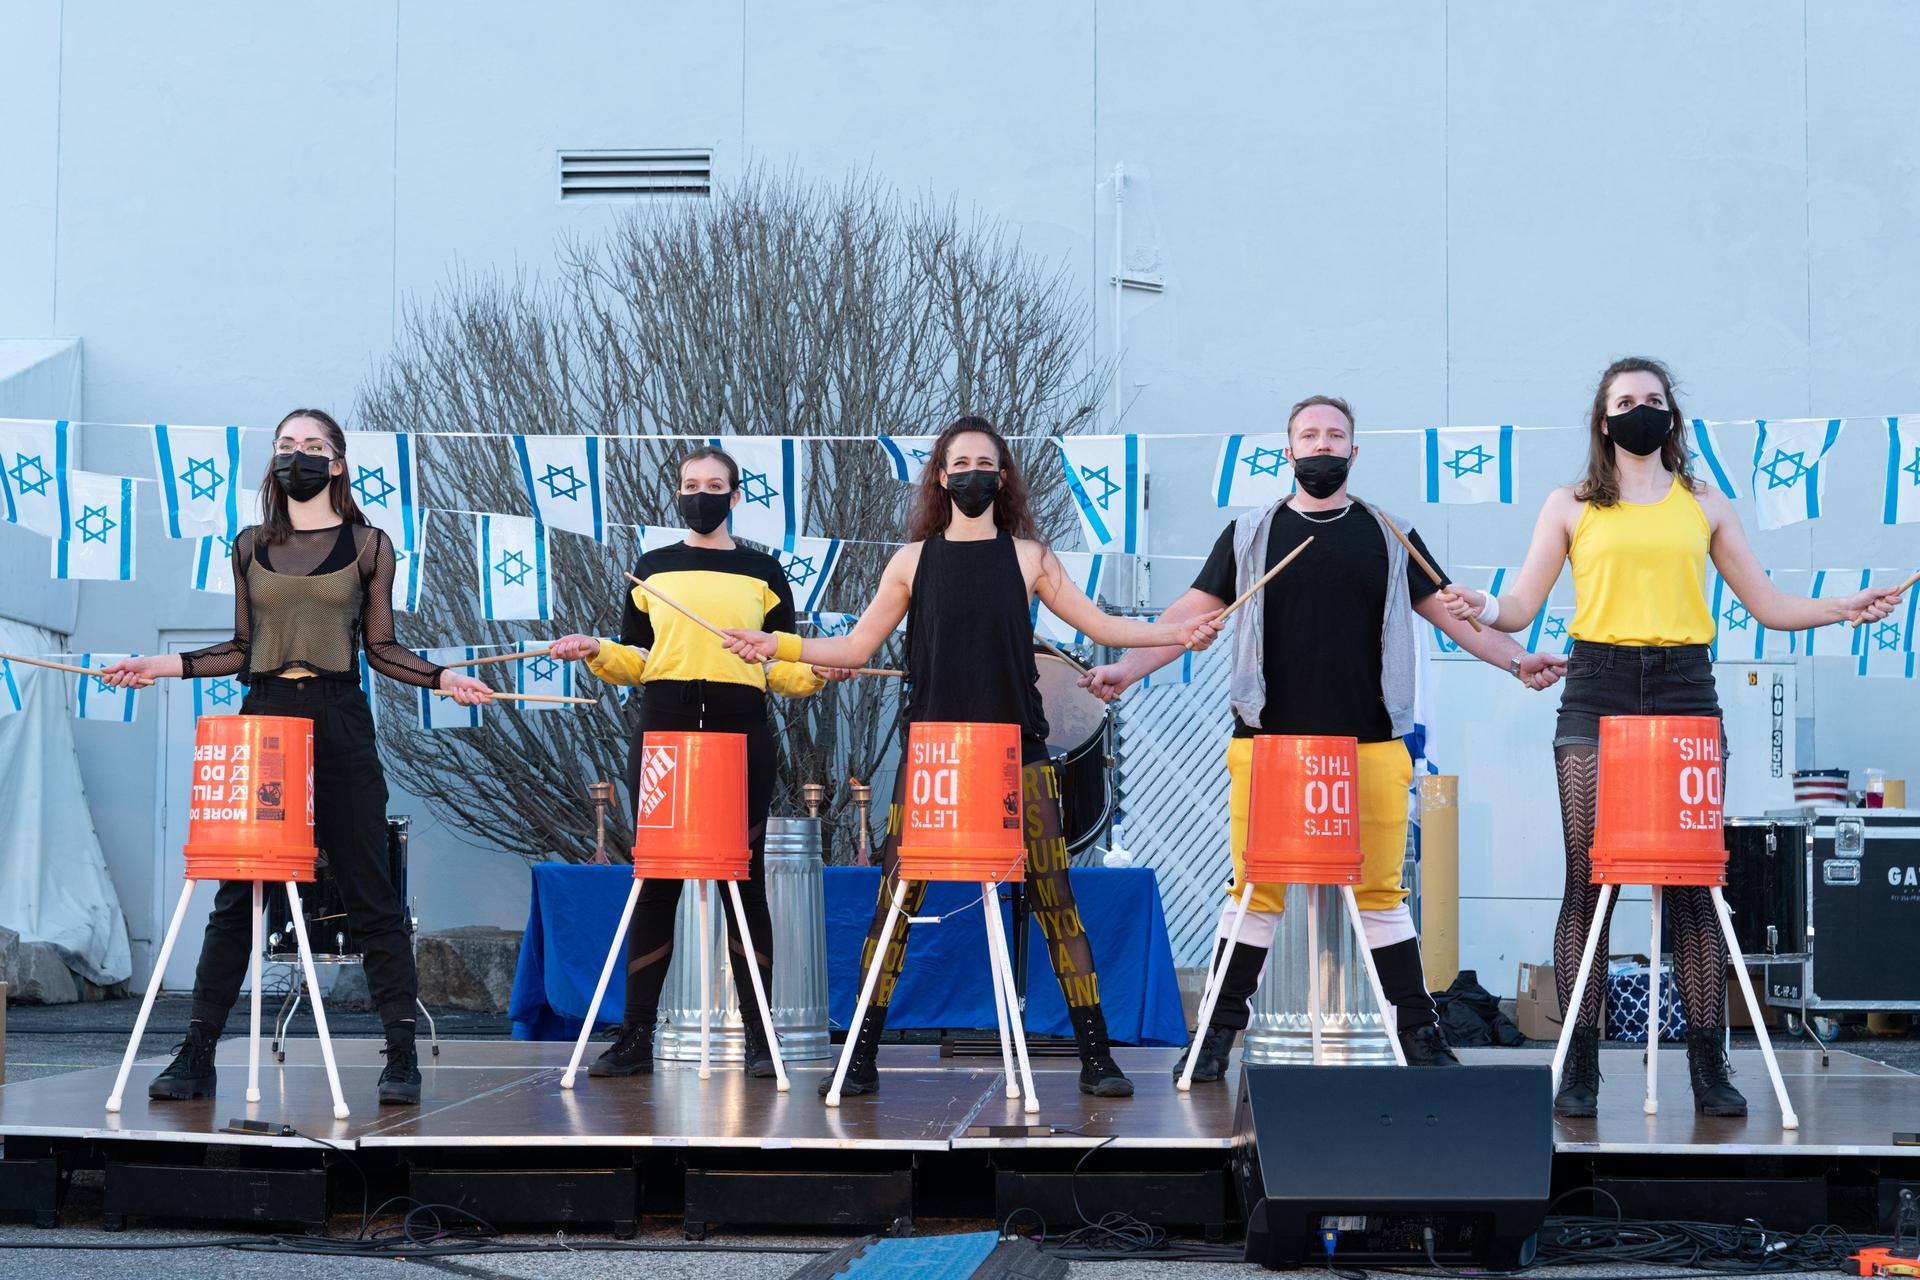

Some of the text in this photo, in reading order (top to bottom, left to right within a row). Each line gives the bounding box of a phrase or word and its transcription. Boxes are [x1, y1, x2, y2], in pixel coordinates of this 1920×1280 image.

[193, 745, 227, 761] REP
[912, 742, 960, 765] THIS.
[1672, 737, 1721, 762] THIS.
[200, 765, 226, 781] DO
[1299, 755, 1351, 776] THIS.
[912, 769, 958, 805] DO
[1679, 766, 1721, 805] DO
[643, 786, 667, 819] THE
[1304, 780, 1350, 815] DO
[203, 808, 248, 821] MORE
[911, 810, 958, 829] LET'S
[1026, 804, 1044, 839] S
[1679, 810, 1722, 830] LET'S
[1304, 818, 1351, 836] LET'S
[1887, 866, 1920, 886] GA
[1058, 943, 1077, 974] A
